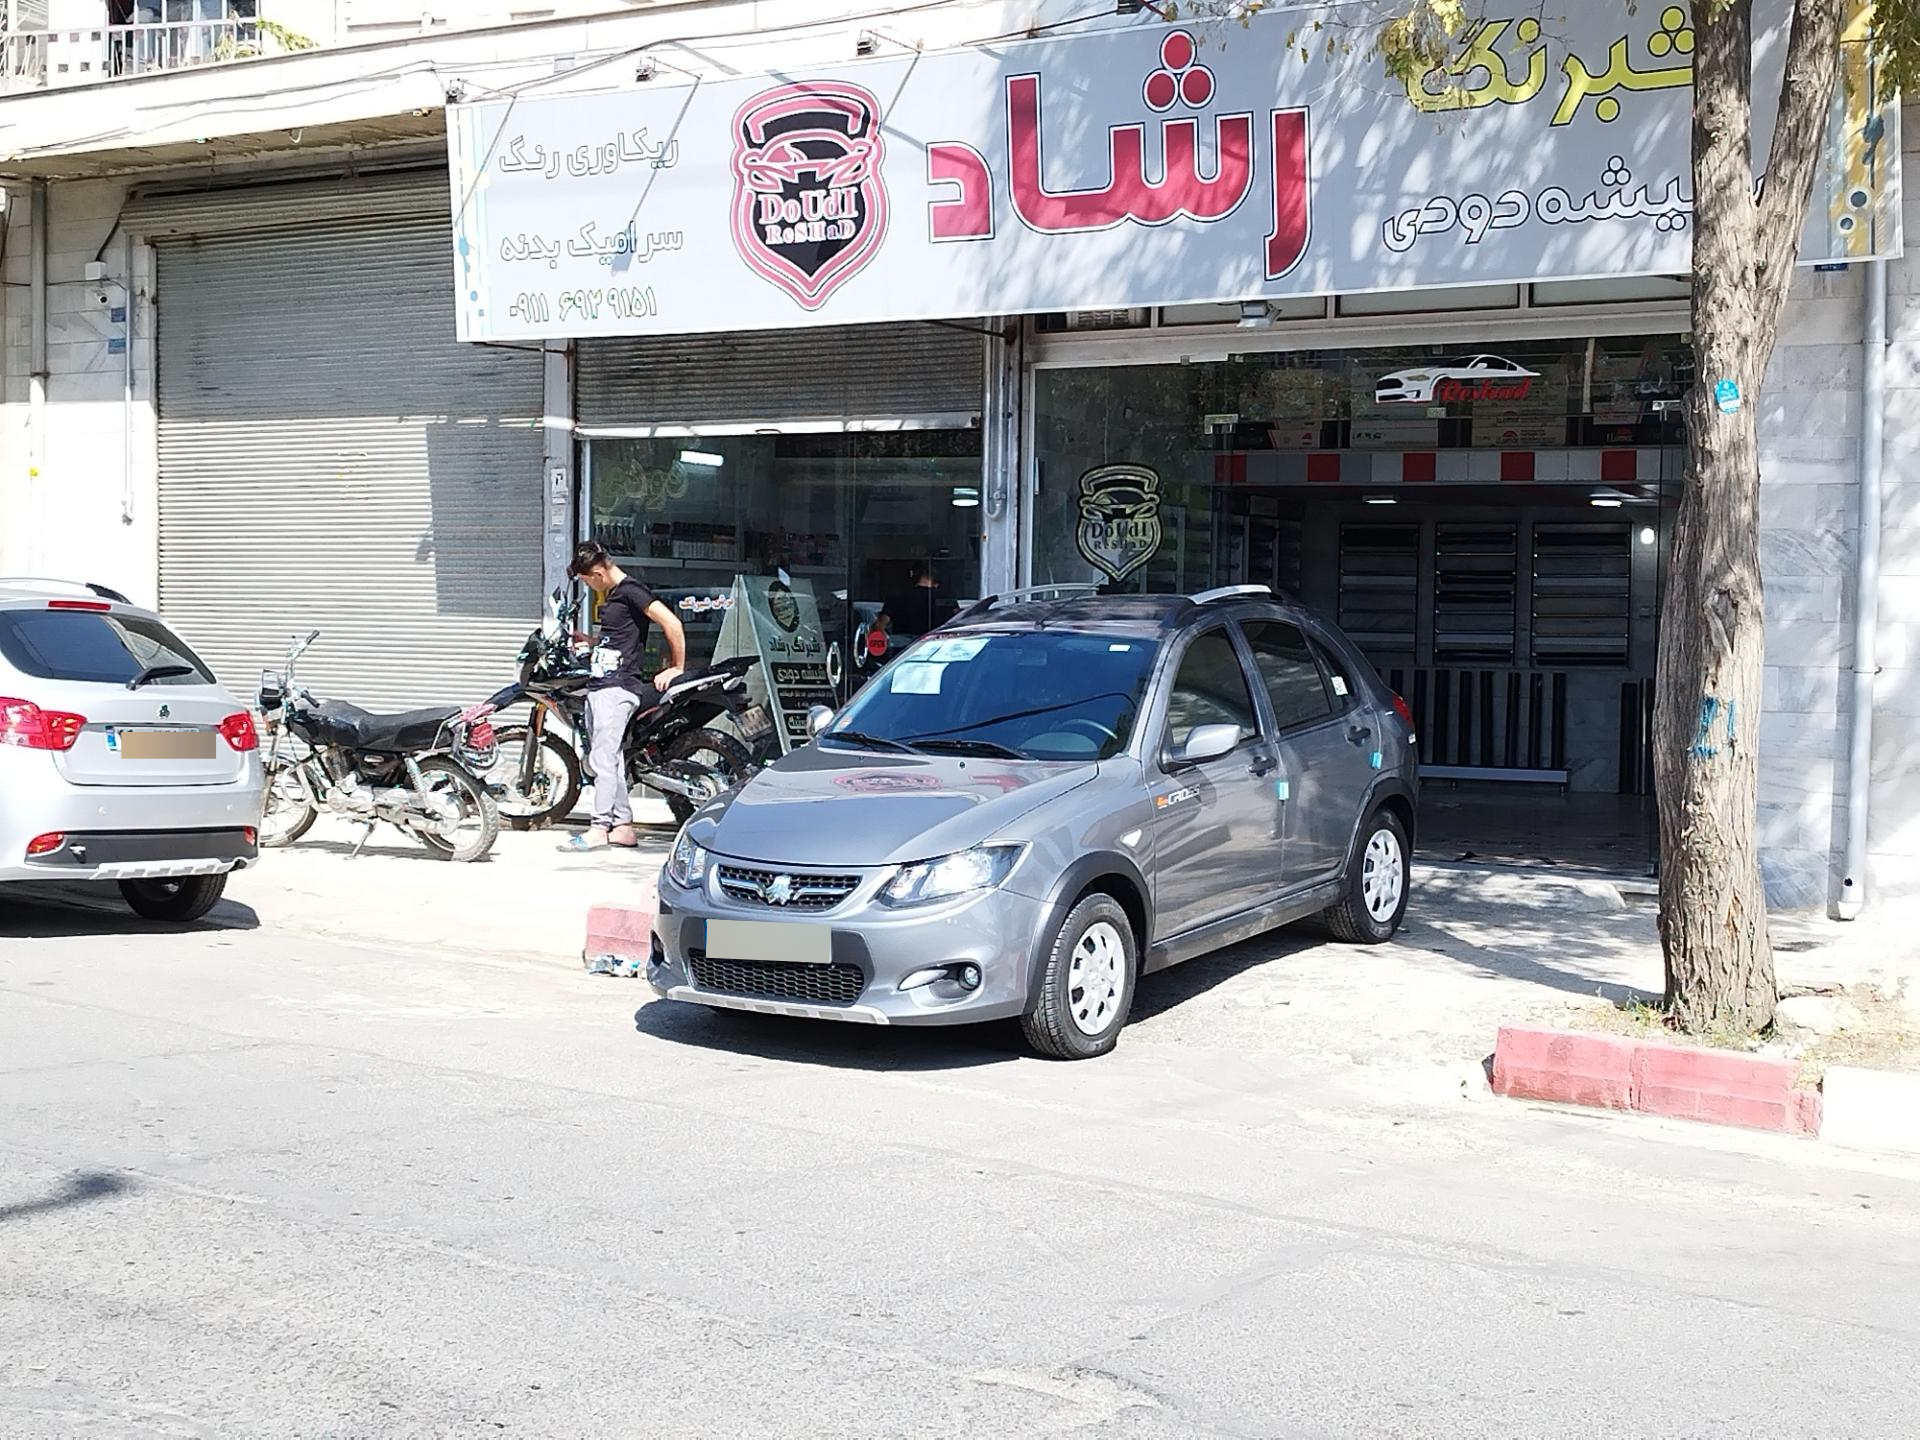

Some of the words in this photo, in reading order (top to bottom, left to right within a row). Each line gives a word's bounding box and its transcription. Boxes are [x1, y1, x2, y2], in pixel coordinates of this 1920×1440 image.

[499, 135, 560, 179] رنگ
[567, 127, 679, 177] ریکاوری
[927, 29, 1312, 281] رشاد
[1535, 155, 1767, 232] یشه
[567, 220, 683, 266] سرامیک
[1382, 189, 1531, 253] دودی
[500, 233, 561, 269] بدنه
[607, 286, 657, 319] ۹۱۵۱
